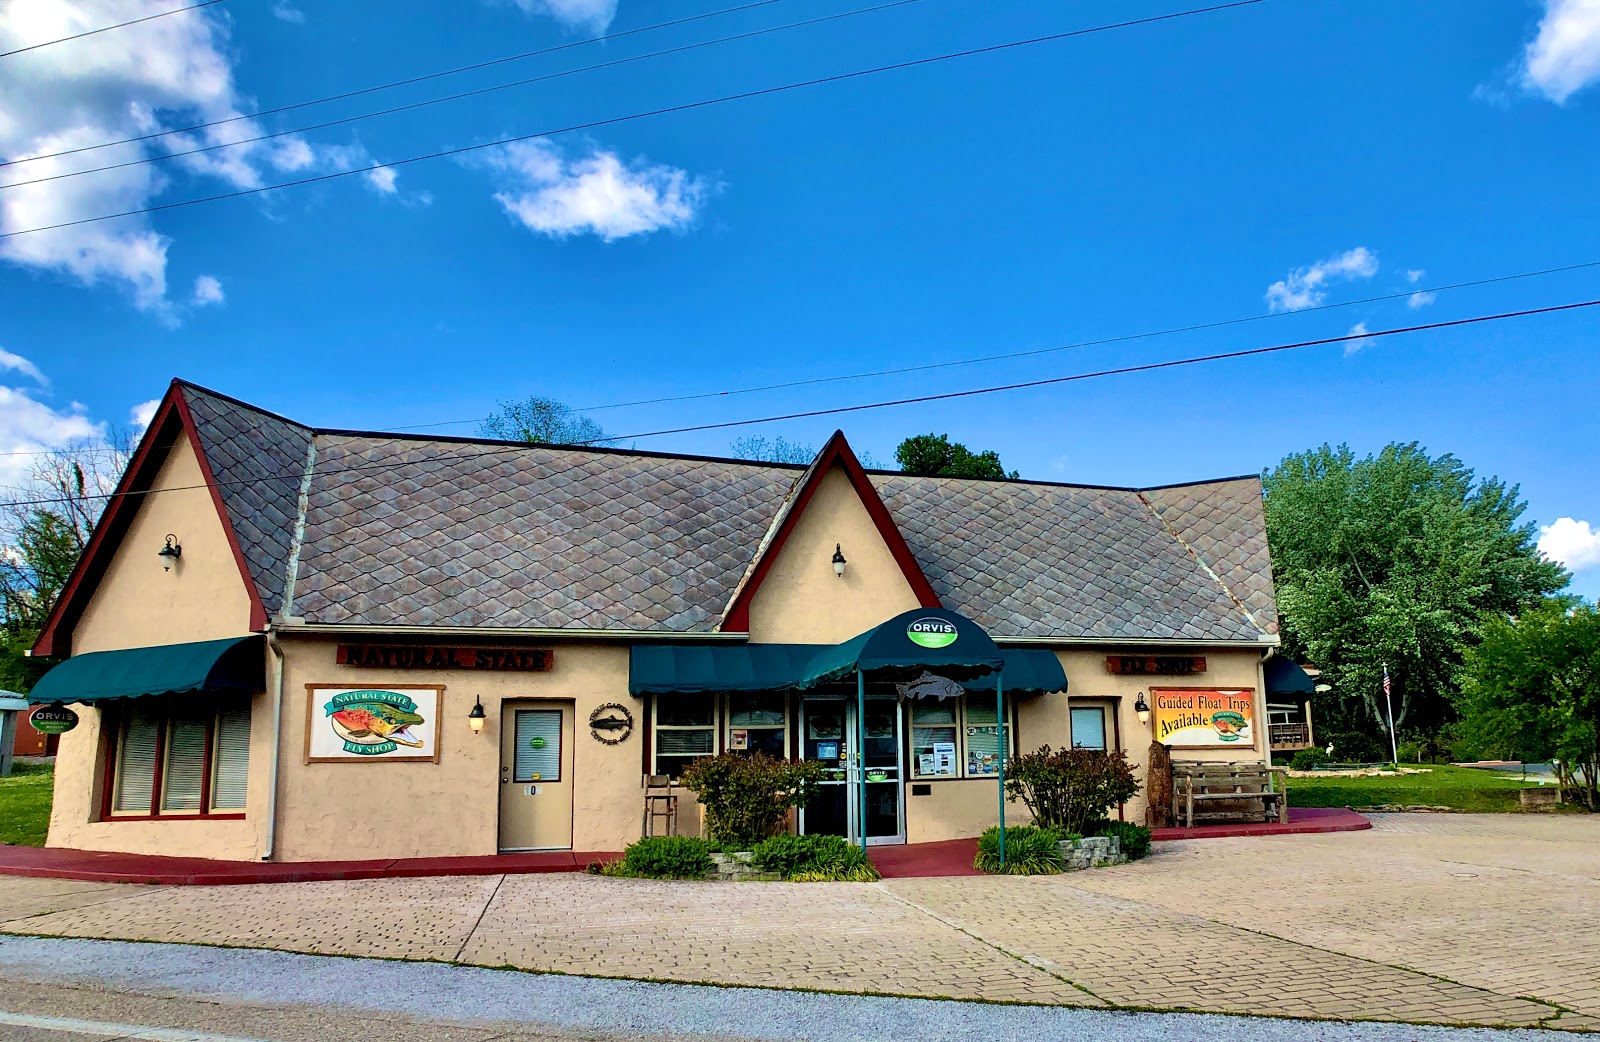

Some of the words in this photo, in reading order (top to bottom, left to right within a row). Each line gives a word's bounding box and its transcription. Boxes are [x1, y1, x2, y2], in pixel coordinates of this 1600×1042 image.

[913, 623, 952, 632] ORVIS
[346, 646, 460, 667] NATURAL
[476, 650, 546, 669] STATE
[336, 693, 379, 704] NATURAL
[381, 693, 409, 706] STATE
[1158, 695, 1193, 709] Guided
[1198, 696, 1222, 709] Float
[1226, 696, 1250, 712] Trips
[36, 712, 74, 720] ORVIS
[1161, 713, 1209, 737] Available
[345, 742, 364, 752] FLY
[366, 741, 395, 753] SHOP
